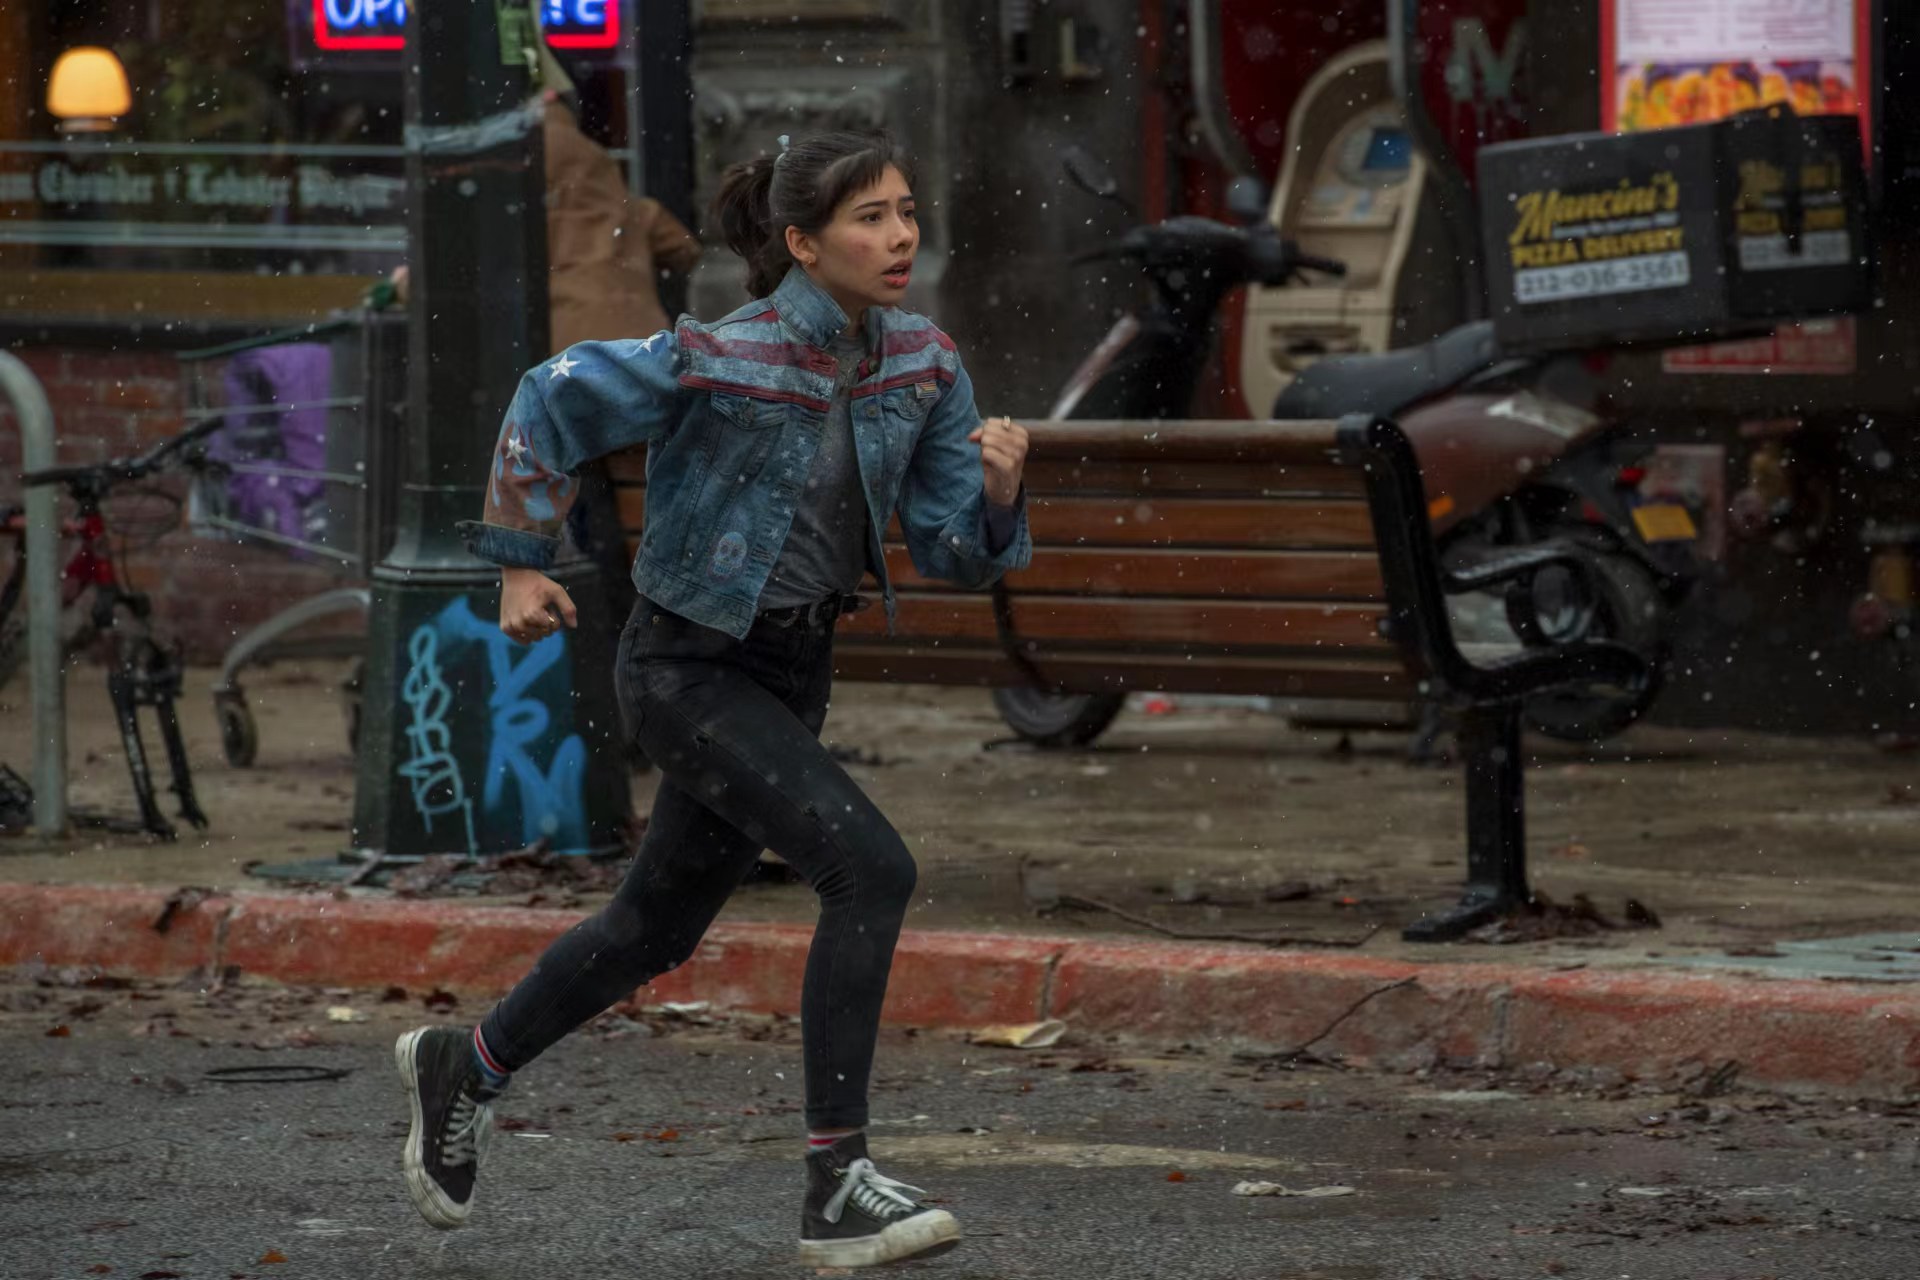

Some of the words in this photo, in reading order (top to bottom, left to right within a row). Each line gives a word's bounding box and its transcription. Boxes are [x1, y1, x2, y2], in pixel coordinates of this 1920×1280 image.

[1508, 170, 1680, 245] Mancini's
[1511, 239, 1579, 268] PIZZA
[1583, 226, 1685, 261] DELIVERY
